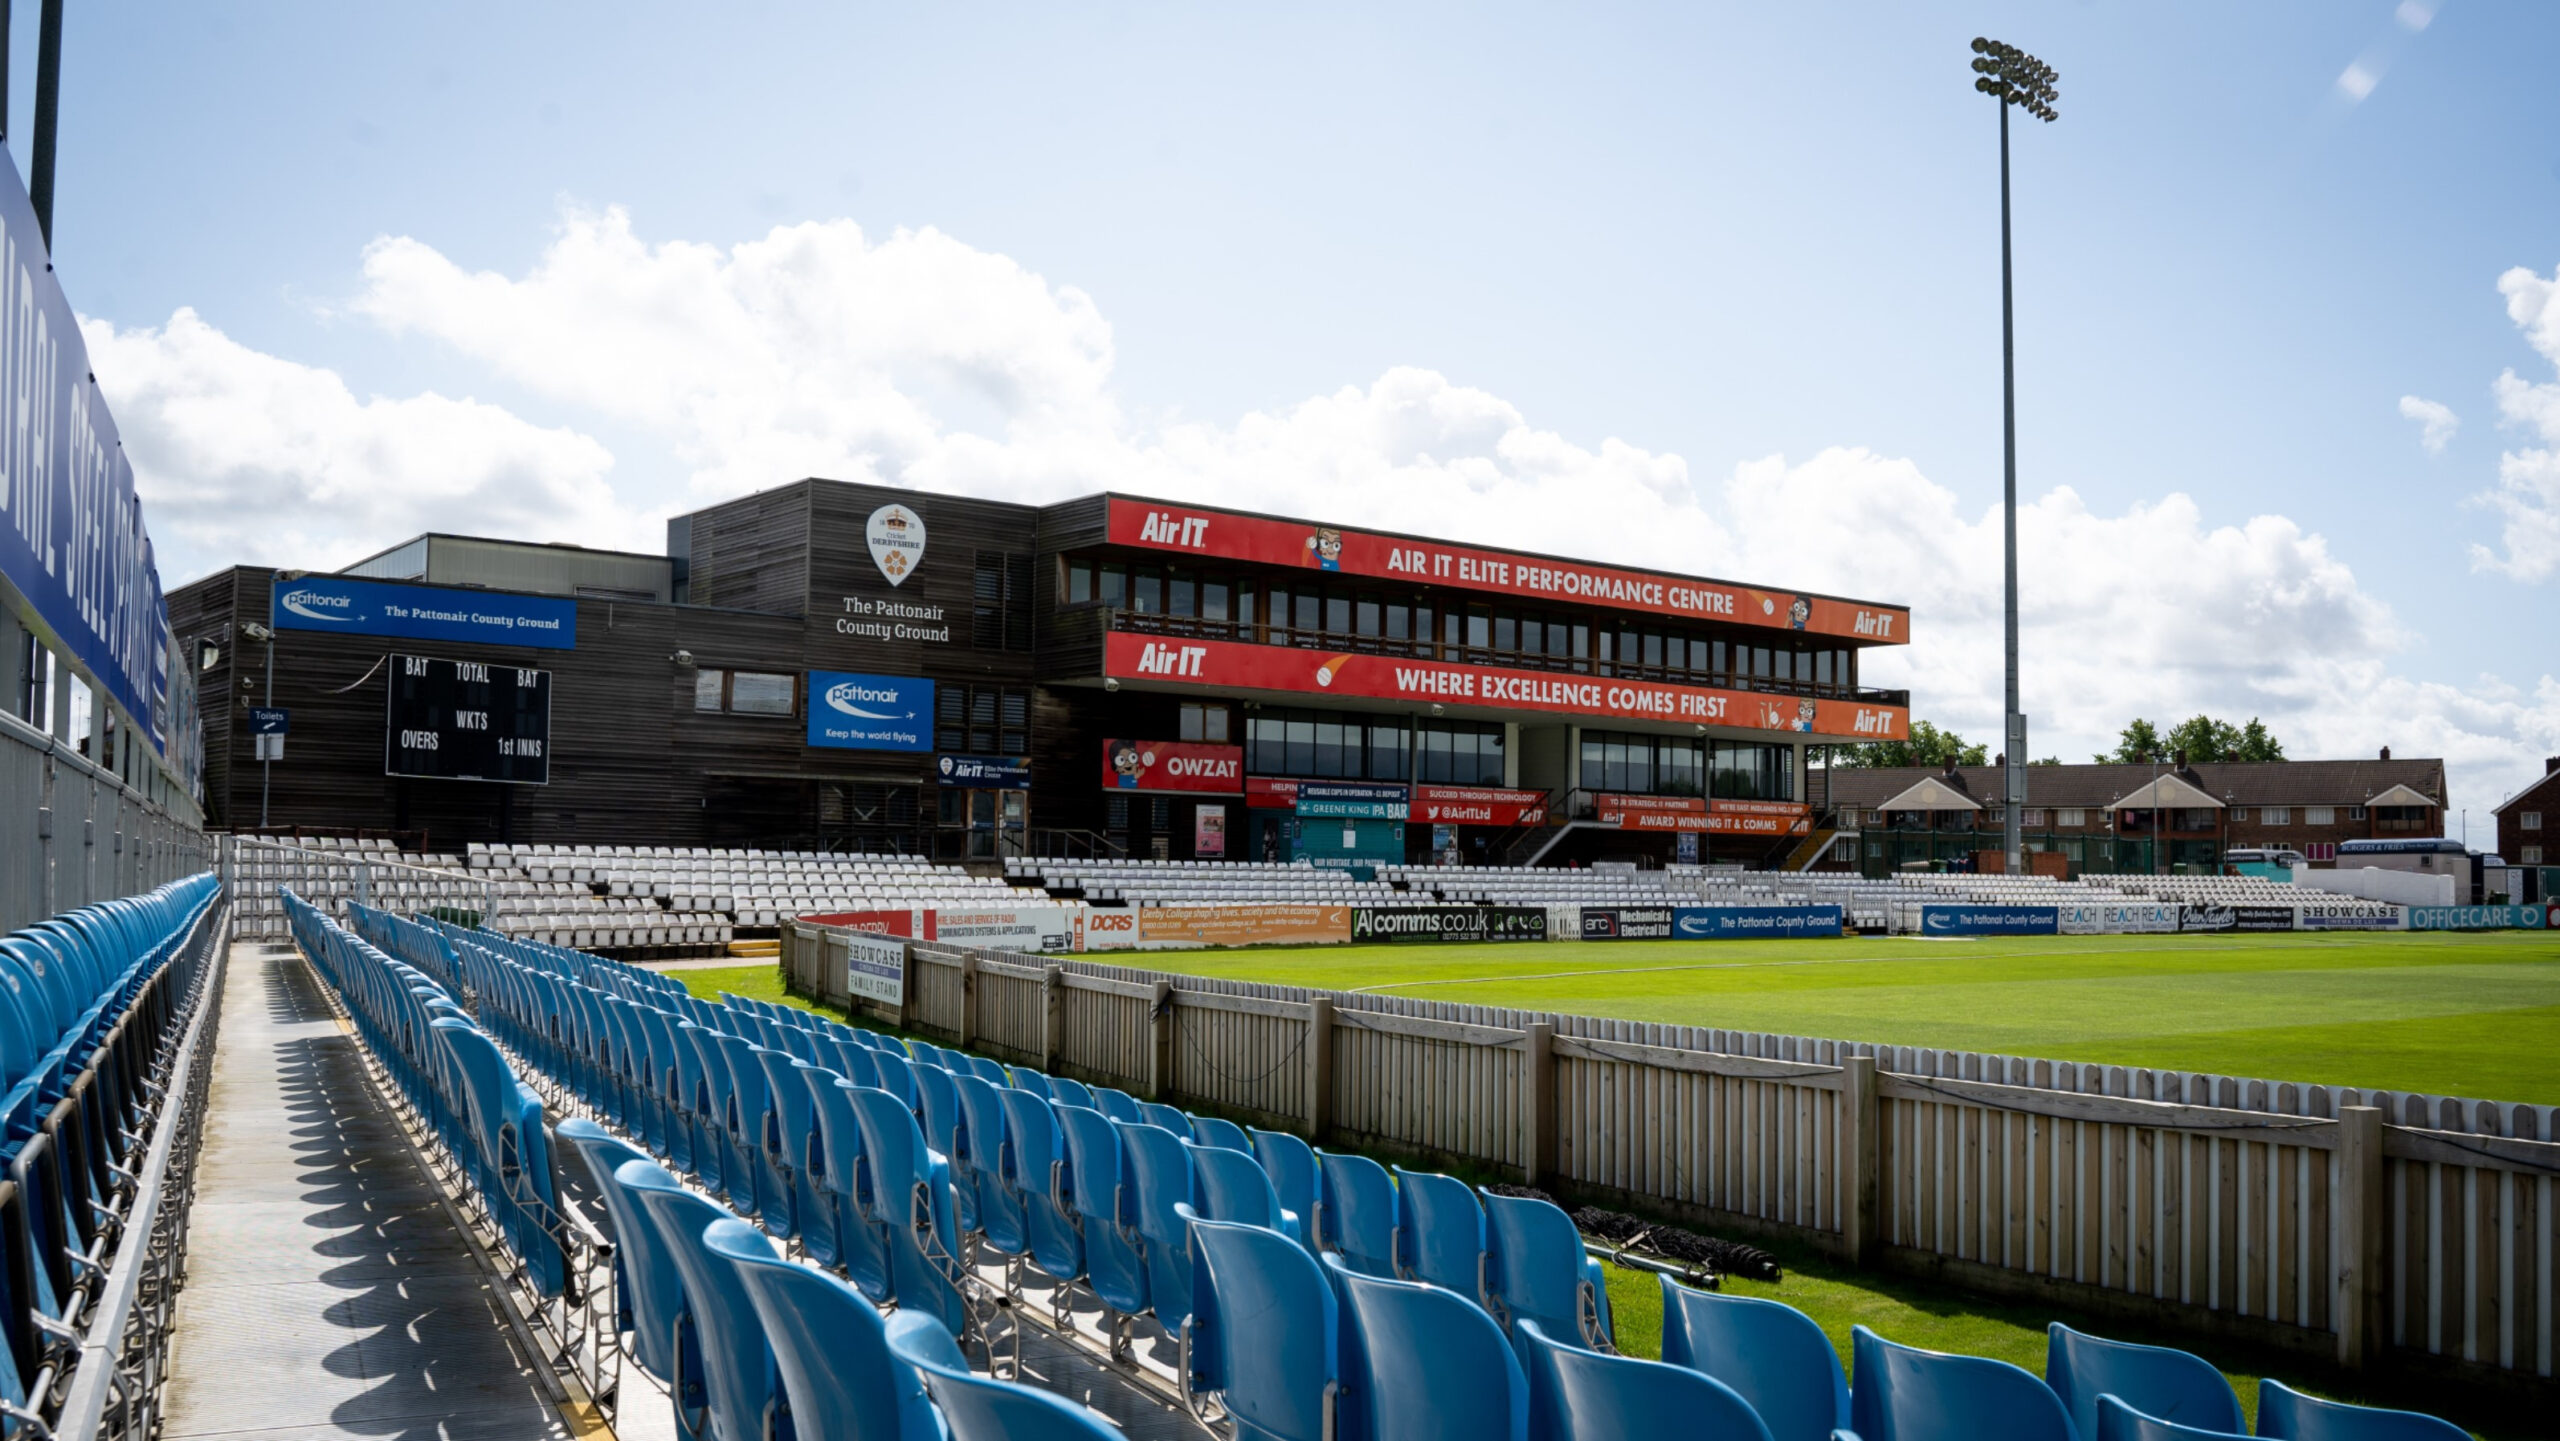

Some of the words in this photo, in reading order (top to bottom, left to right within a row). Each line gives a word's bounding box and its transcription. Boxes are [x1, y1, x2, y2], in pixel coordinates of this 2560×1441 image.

[66, 382, 109, 644] STEEL
[872, 538, 920, 549] DERBYSHIRE
[1388, 548, 1427, 575] AIR
[1434, 554, 1453, 577] IT
[1459, 558, 1509, 585] ELITE
[1516, 565, 1663, 605] PERFORMANCE
[1669, 586, 1733, 614] CENTRE
[288, 592, 351, 608] pattonair
[843, 597, 872, 615] The
[876, 600, 944, 620] Pattonair
[385, 605, 409, 618] The
[411, 607, 468, 622] Pattonair
[471, 612, 514, 628] County
[517, 616, 560, 630] Ground
[837, 619, 891, 640] County
[895, 622, 949, 642] Ground
[405, 657, 428, 677] BAT
[456, 664, 490, 684] TOTAL
[517, 670, 538, 688] BAT
[832, 685, 898, 703] pattonair
[1396, 668, 1475, 696] WHERE
[1482, 675, 1601, 707] EXCELLENCE
[1608, 687, 1674, 713] COMES
[1681, 693, 1727, 717] FIRST
[255, 711, 284, 722] Toilets
[456, 710, 488, 731] WKTS
[401, 730, 439, 751] OVERS
[825, 728, 849, 740] Keep
[851, 730, 865, 739] the
[867, 730, 891, 741] world
[893, 732, 917, 743] flying
[499, 737, 514, 755] 1st
[517, 739, 541, 757] INNS
[997, 766, 1029, 774] Performance
[1168, 757, 1237, 778] OWZAT
[1271, 783, 1298, 792] HELPIN
[1307, 787, 1330, 796] REUSABLE
[1331, 788, 1341, 796] CUPS
[1349, 789, 1372, 797] OPERATION
[1382, 790, 1401, 798] DEPOSIT
[1429, 790, 1457, 798] SUCCEED
[1460, 791, 1491, 800] THROUGH
[1494, 793, 1536, 801] TECHNOLOGY
[1313, 804, 1346, 814] GREENE
[1348, 805, 1369, 815] KING
[1372, 805, 1385, 816] IPA
[1387, 803, 1407, 819] BAR
[1628, 799, 1657, 807] STRATEGIC
[1665, 801, 1689, 809] PARTNER
[1442, 806, 1491, 820] @AirITLtd
[1640, 816, 1675, 826] AWARD
[1677, 816, 1722, 829] WINNING
[1724, 818, 1732, 829] IT
[1734, 819, 1741, 829] &
[1743, 820, 1776, 830] COMMS
[950, 915, 963, 925] SALES
[964, 914, 973, 924] AND
[974, 914, 993, 924] SERVICE
[994, 914, 1000, 924] OF
[1001, 913, 1016, 923] RADIO
[1142, 908, 1163, 920] Derby
[1166, 908, 1193, 920] College
[1194, 907, 1220, 919] shaping
[1241, 907, 1263, 917] society
[1264, 907, 1277, 915] and
[1278, 907, 1289, 915] the
[1290, 908, 1321, 917] economy
[1619, 910, 1664, 923] Mechanical
[1666, 911, 1672, 921] &
[2061, 907, 2096, 922] REACH
[2104, 907, 2139, 922] REACH
[2142, 907, 2176, 921] REACH
[2182, 906, 2206, 924] Owen
[2205, 906, 2236, 929] Taylor
[2303, 907, 2399, 917] SHOWCASE
[2414, 907, 2512, 928] OFFICECARE
[1090, 914, 1133, 931] DCRS
[1585, 918, 1608, 930] arc
[1721, 917, 1735, 928] The
[1738, 916, 1774, 928] Pattonair
[1776, 916, 1805, 929] County
[1807, 914, 1836, 926] Ground
[1960, 914, 1973, 925] The
[1974, 913, 2003, 925] Pattonair
[2004, 914, 2028, 927] County
[2030, 914, 2053, 925] Ground
[938, 927, 974, 938] COMMUNICATION
[975, 926, 997, 936] SYSTEMS
[1002, 925, 1036, 936] APPLICATIONS
[1621, 923, 1657, 937] Electrical
[1659, 923, 1670, 935] Ltd
[850, 943, 902, 967] SHOWCASE
[851, 975, 873, 991] FAMILY
[876, 980, 897, 998] STAND
